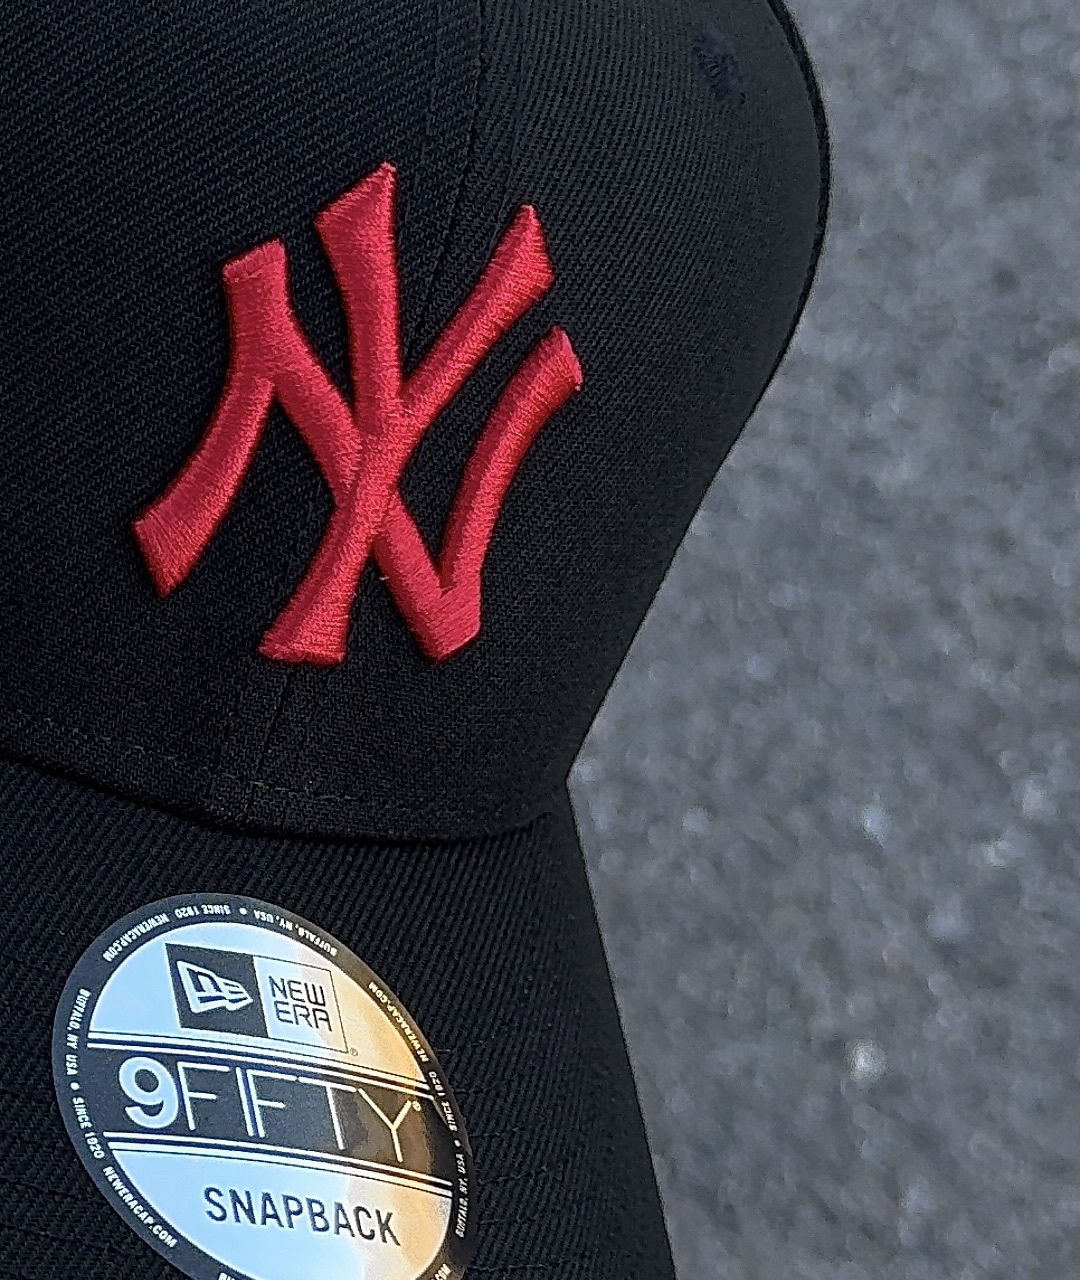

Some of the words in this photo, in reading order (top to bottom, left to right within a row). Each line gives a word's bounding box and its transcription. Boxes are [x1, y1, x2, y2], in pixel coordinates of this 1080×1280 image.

[131, 160, 584, 667] NY
[269, 975, 327, 1006] NEW
[273, 1000, 333, 1032] ERA
[72, 1097, 92, 1129] SINCE
[103, 1166, 178, 1247] NEWERACAP.COM
[203, 1186, 401, 1246] SNAPBACK
